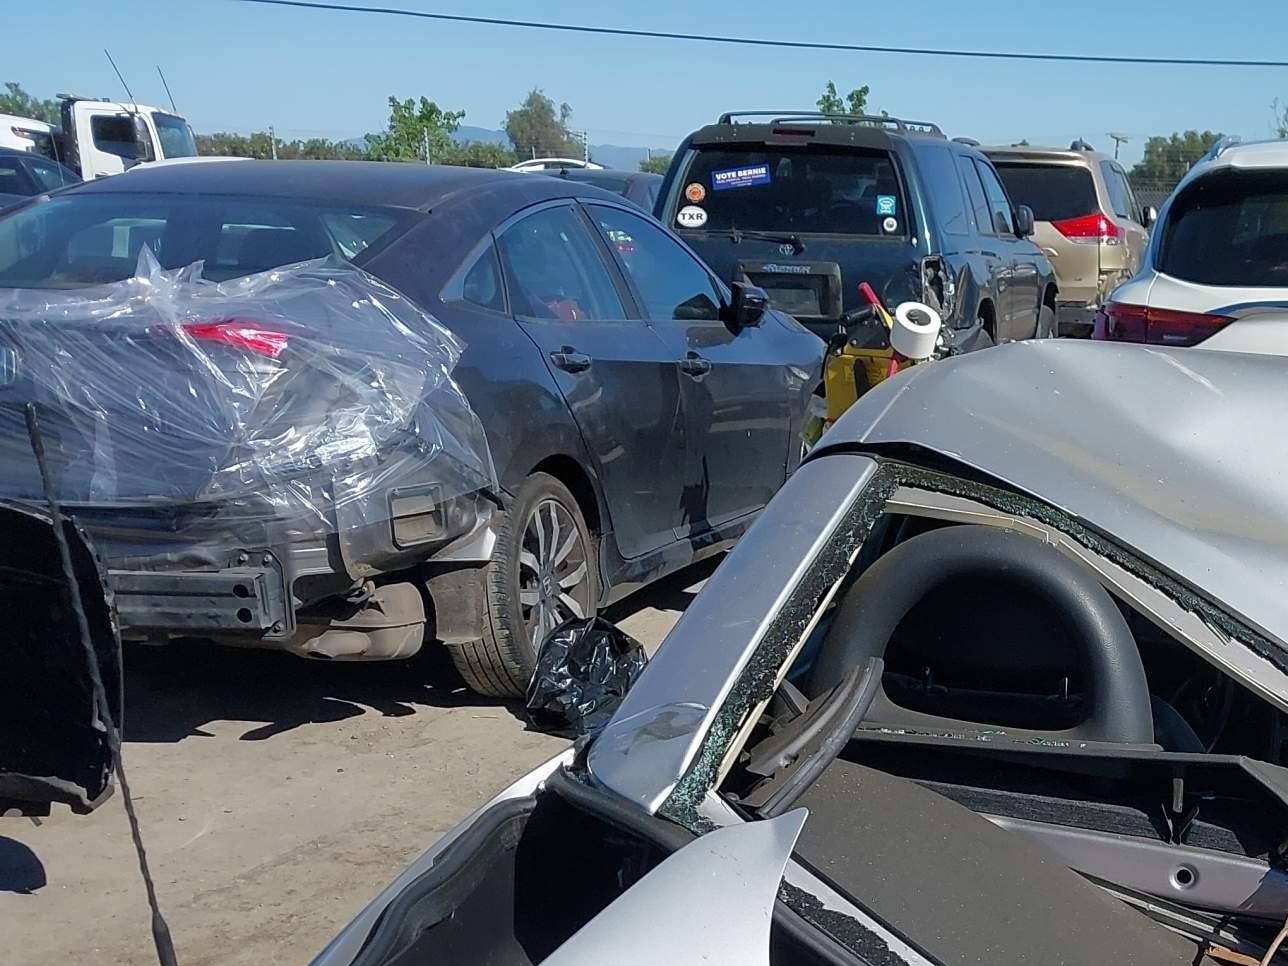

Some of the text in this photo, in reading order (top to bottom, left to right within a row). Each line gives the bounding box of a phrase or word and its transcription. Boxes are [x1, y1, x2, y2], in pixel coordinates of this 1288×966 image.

[715, 171, 737, 180] VOTE
[737, 167, 767, 176] BERNIE
[680, 212, 704, 221] TXR
